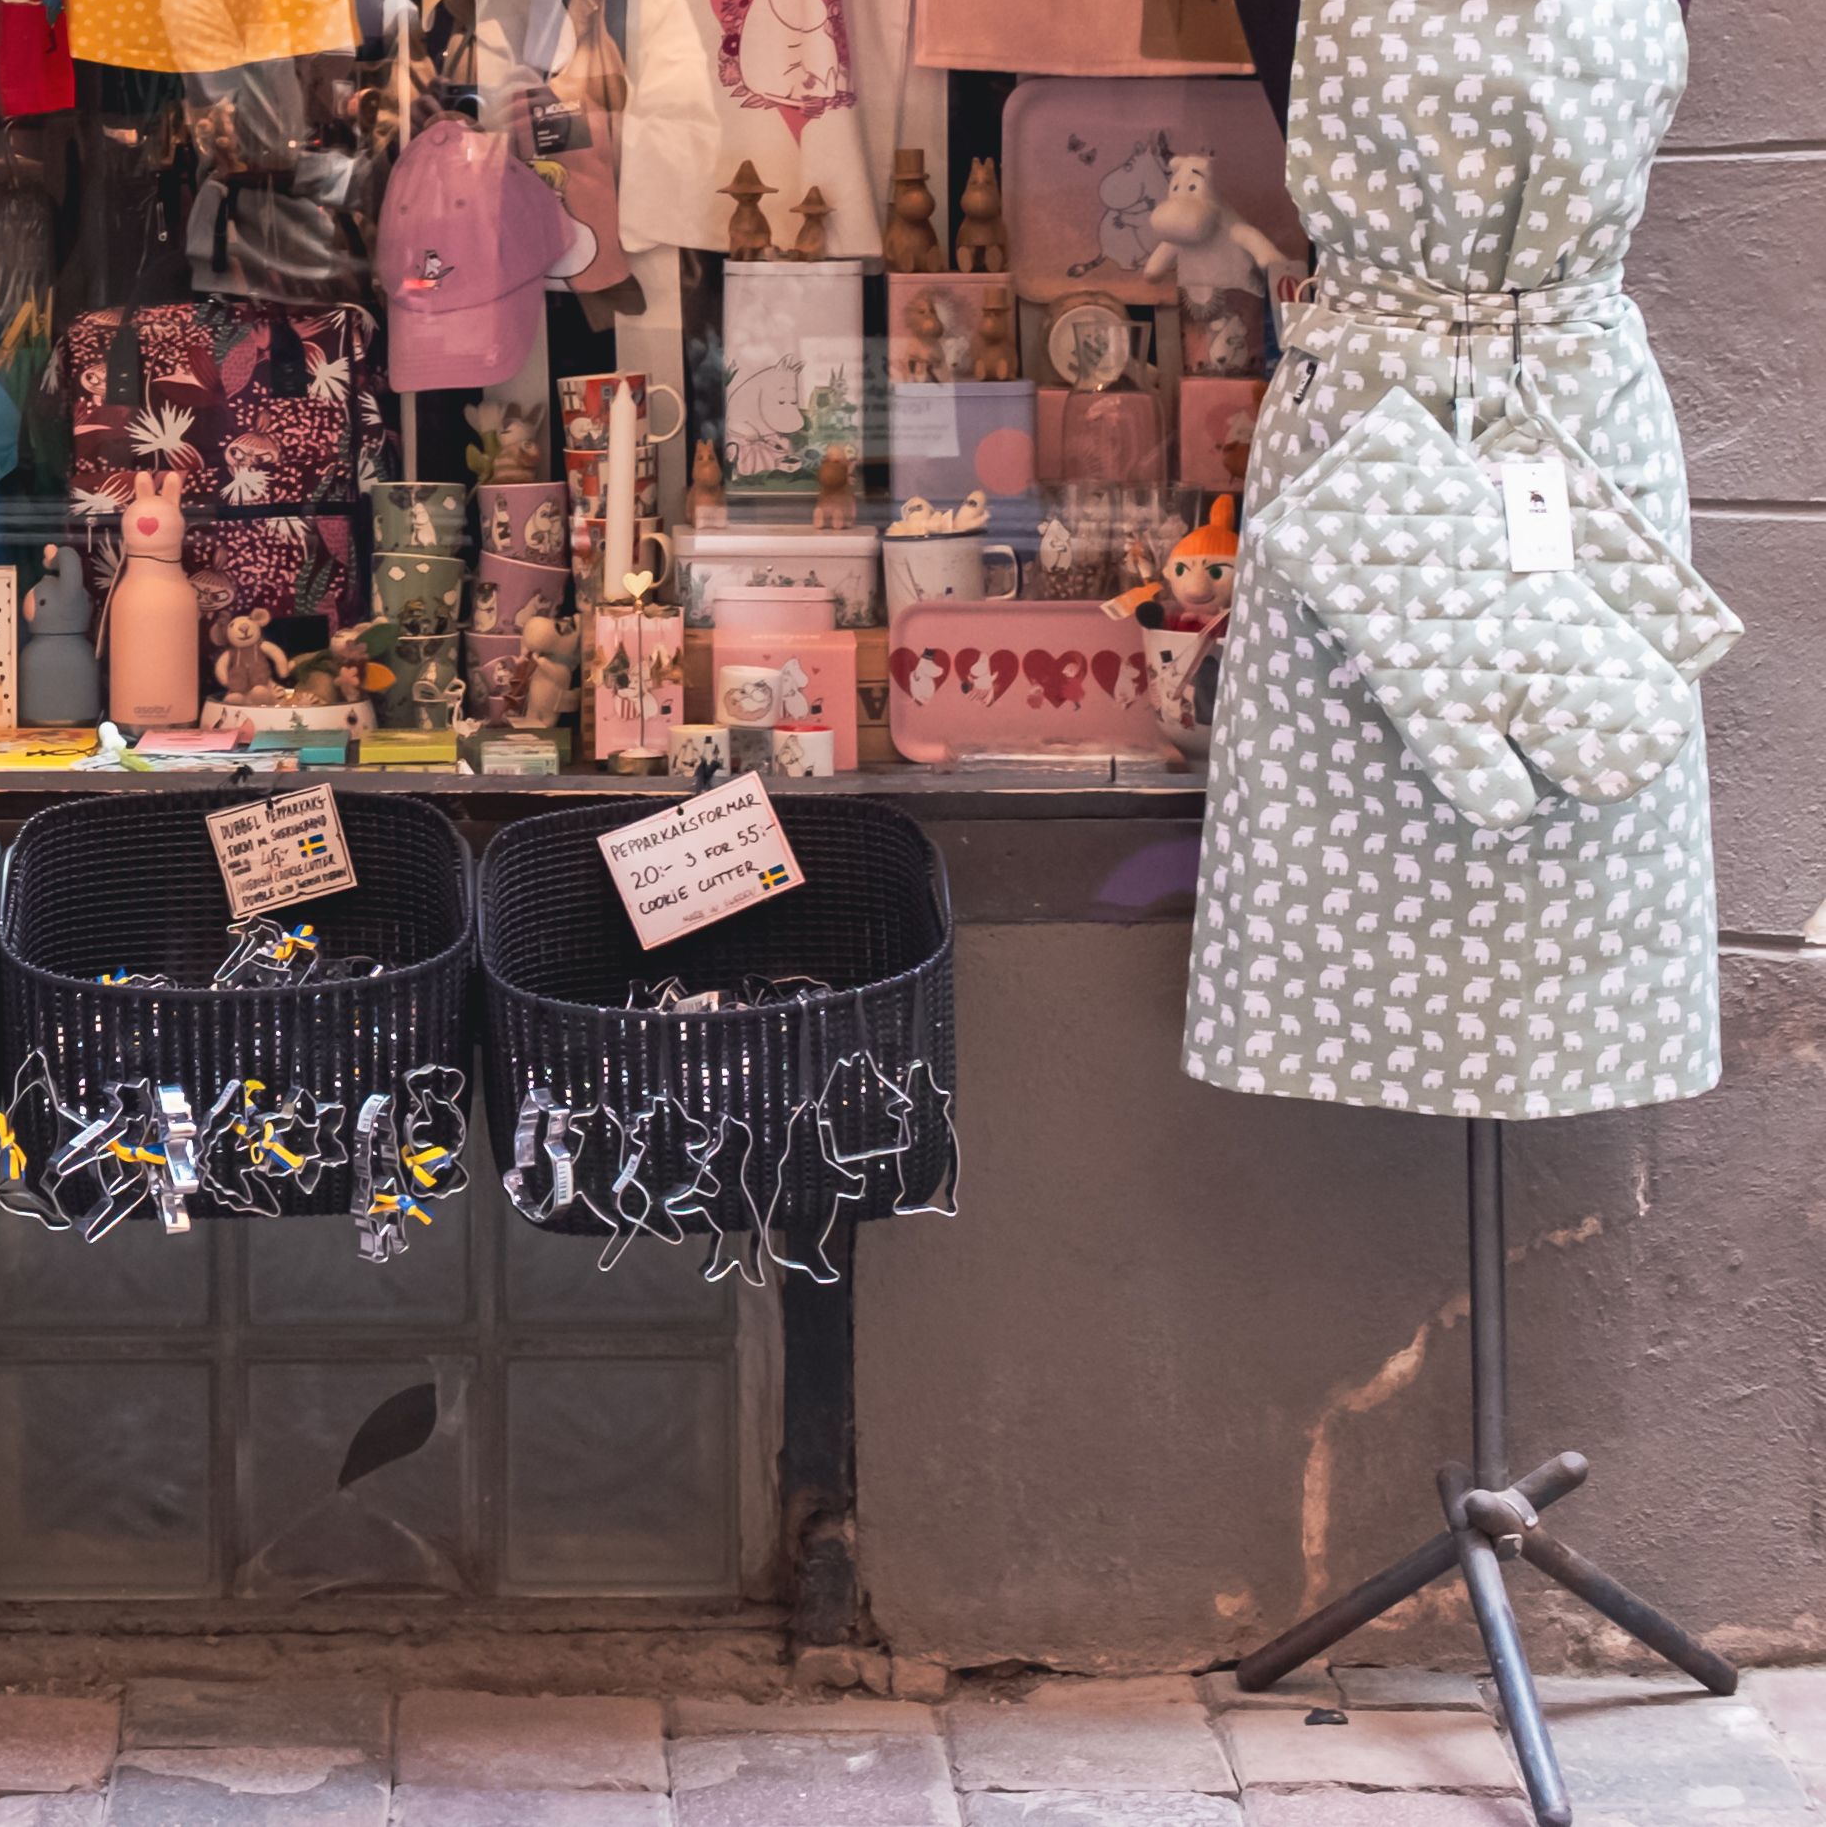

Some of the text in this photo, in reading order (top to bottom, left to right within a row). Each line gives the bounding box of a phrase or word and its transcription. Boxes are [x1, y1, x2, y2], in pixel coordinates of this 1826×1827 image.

[610, 792, 762, 862] PEPPARKAKSFORMAR
[684, 850, 698, 869] 3
[704, 840, 734, 861] FOR
[638, 860, 760, 916] COOKIE CUTTER
